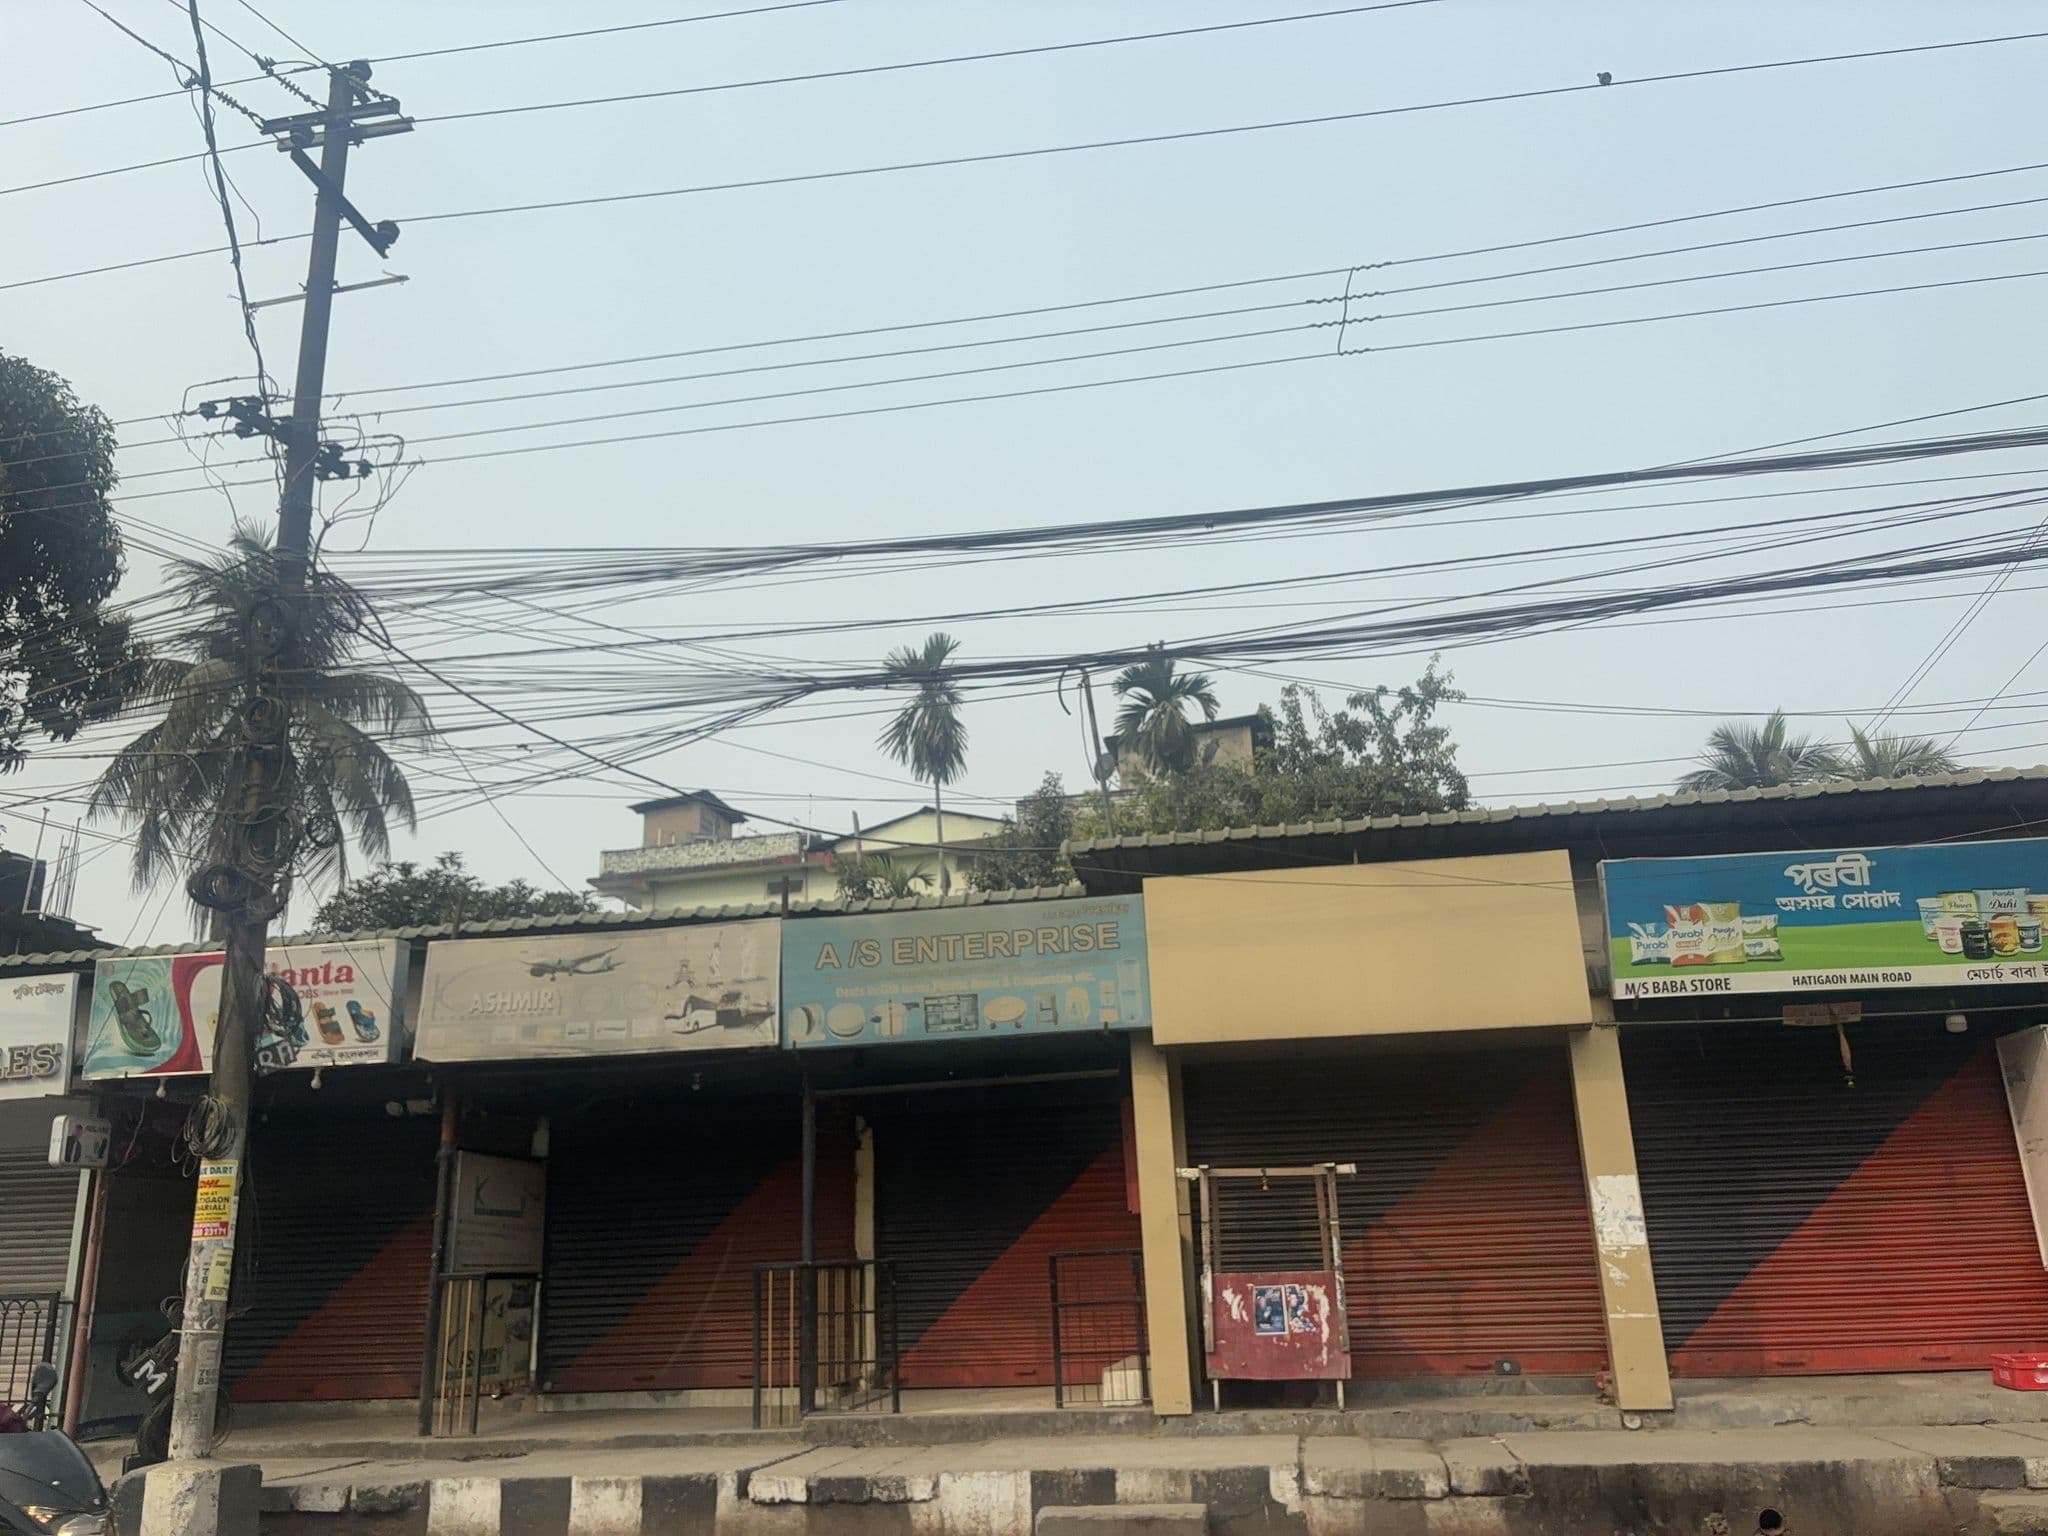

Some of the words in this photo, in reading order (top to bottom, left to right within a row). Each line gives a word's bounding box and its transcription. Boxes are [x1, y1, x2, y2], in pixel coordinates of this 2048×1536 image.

[1988, 899, 2017, 910] Dahi
[1672, 928, 1704, 939] Purabi
[814, 943, 842, 969] A
[892, 921, 1121, 965] ENTERPRISE
[1636, 940, 1669, 950] Purabi
[1792, 974, 1847, 986] HATIGAON
[1849, 972, 1880, 984] MAIN
[1882, 971, 1913, 983] ROAD
[2010, 965, 2037, 979] বাবা
[1625, 981, 1650, 996] M/S
[1652, 979, 1688, 994] BABA
[1690, 977, 1732, 992] STORE
[0, 1043, 64, 1079] ES
